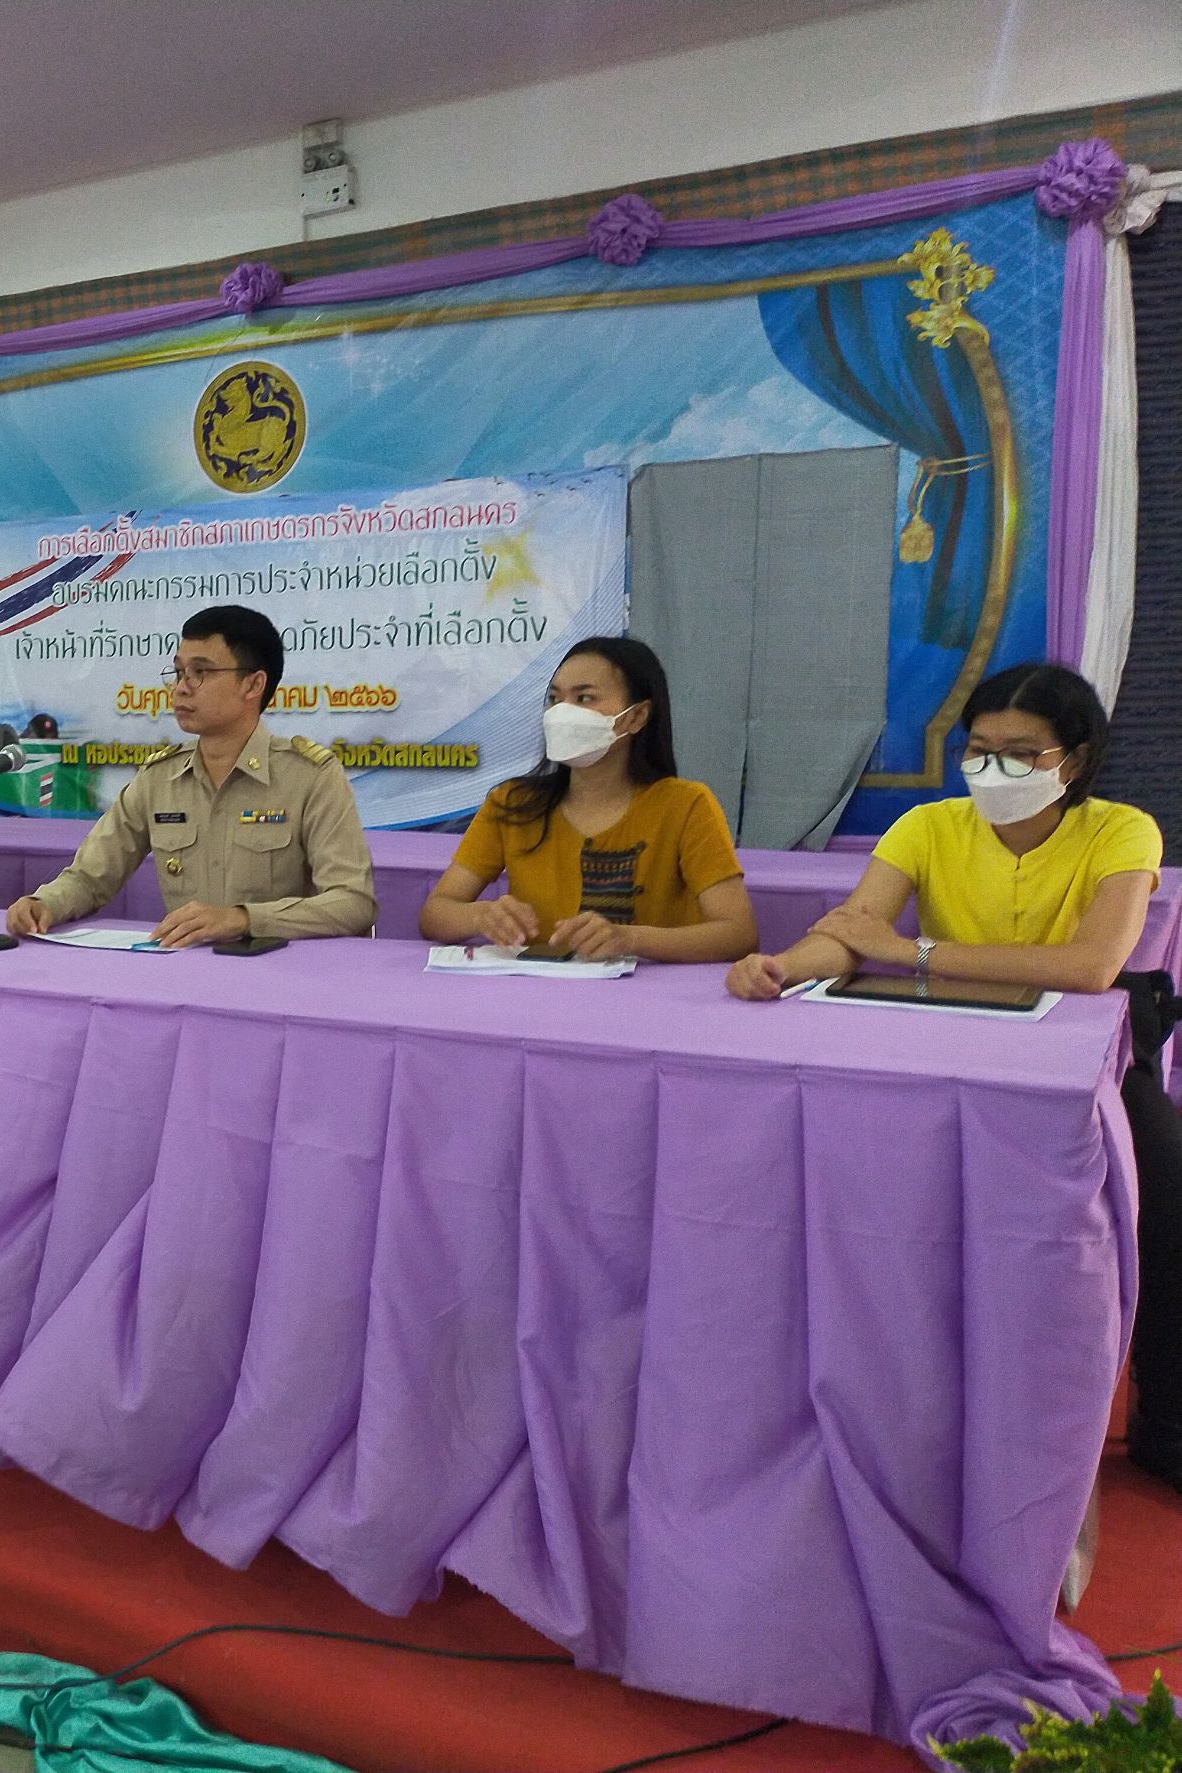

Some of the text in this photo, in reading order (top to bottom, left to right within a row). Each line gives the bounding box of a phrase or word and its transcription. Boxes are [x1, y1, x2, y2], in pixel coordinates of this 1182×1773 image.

[38, 501, 517, 557] การเลือกตั้งสมาชิกสภาเกษตรกรจังหวัดสกลนคร
[51, 538, 497, 606] อบรมคณะกรรมการประจำหน่วยเลือกตั้ง
[323, 683, 398, 708] ๒๕๖๖
[62, 743, 79, 764] ณ
